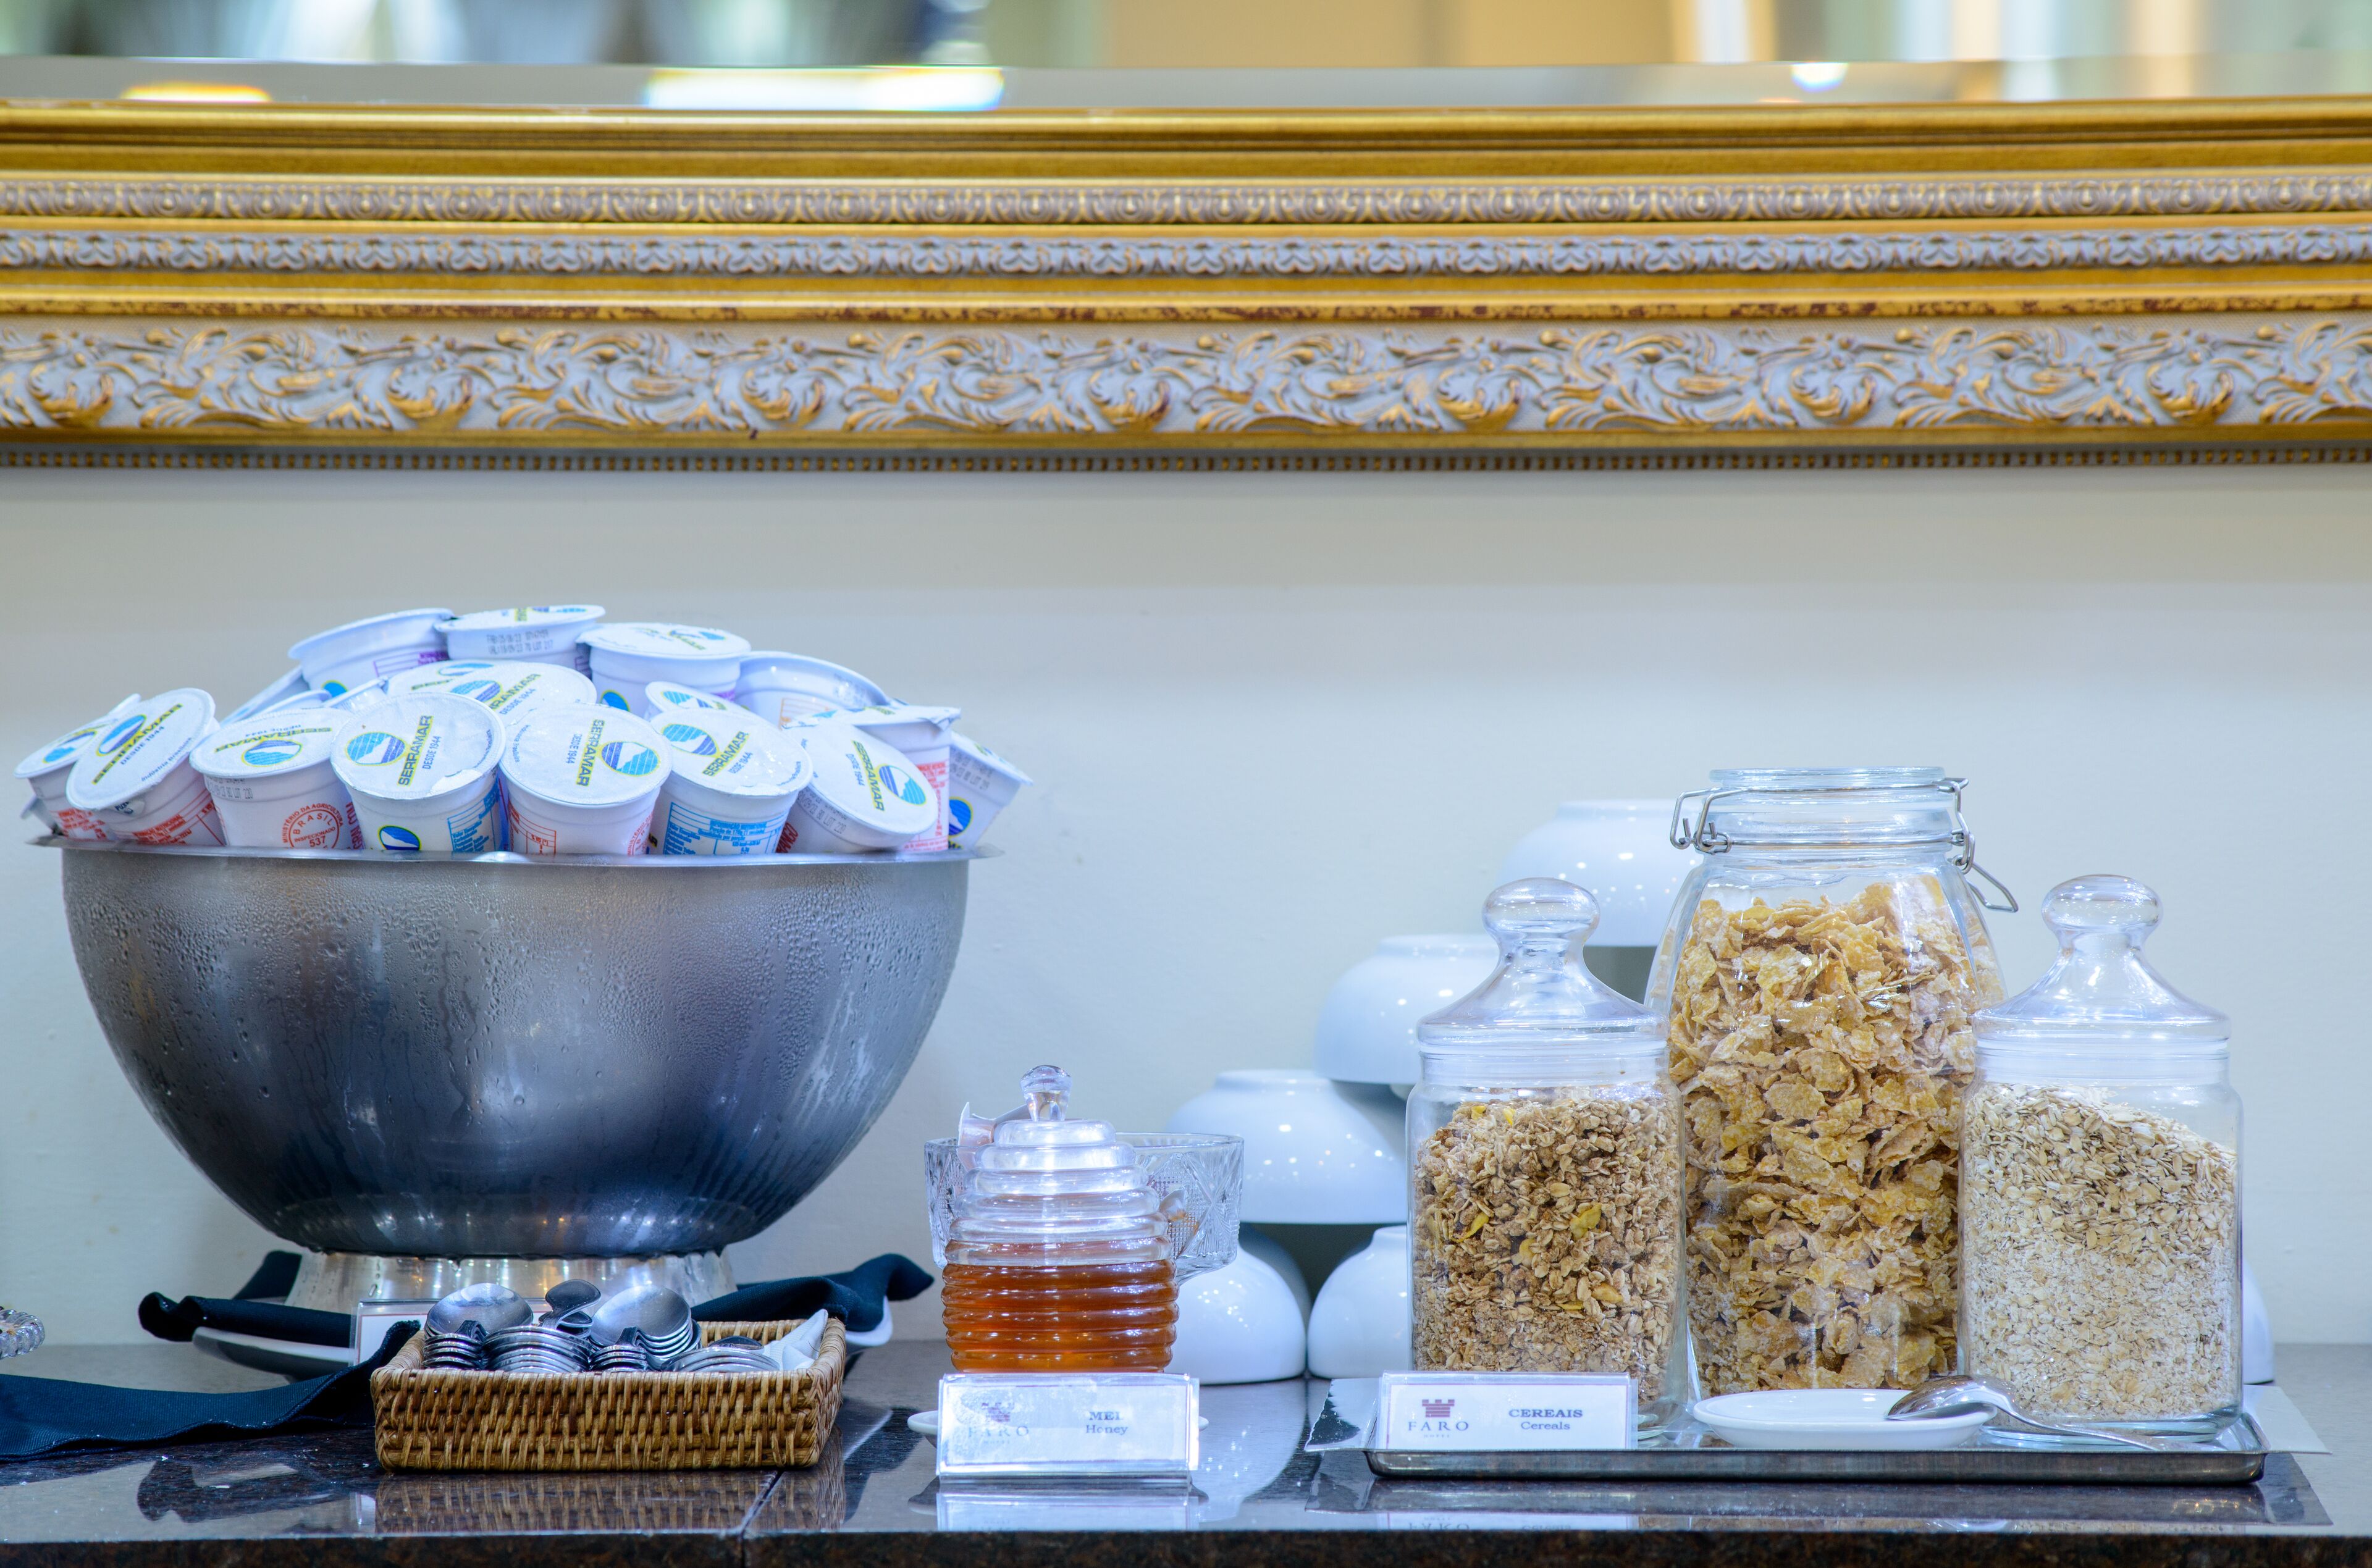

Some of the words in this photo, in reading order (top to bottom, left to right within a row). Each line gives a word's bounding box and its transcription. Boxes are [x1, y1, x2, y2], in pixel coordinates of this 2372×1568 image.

[500, 700, 520, 715] DESDE
[519, 688, 536, 702] 1944
[93, 703, 182, 784] SERRAMAR
[120, 742, 146, 765] DESDE
[146, 726, 165, 742] 1944
[215, 727, 332, 753] SERRAMAR
[398, 716, 433, 786] SERRAMAR
[423, 750, 435, 769] DESDE
[430, 736, 442, 750] 1944
[571, 733, 582, 749] DESDE
[578, 719, 604, 786] SERRAMAR
[566, 748, 577, 764] 1944
[703, 731, 749, 777] SERRAMAR
[728, 761, 742, 774] DESDE
[740, 752, 753, 766] 1944
[846, 753, 860, 773] DESDE
[854, 771, 865, 787] 1944
[852, 740, 885, 811] SERRAMAR
[282, 810, 300, 843] MINISTÉRIO
[300, 805, 310, 814] DA
[311, 803, 343, 827] AGRICULTURA
[293, 812, 333, 835] BRASIL
[294, 826, 335, 843] INSPECIONADO
[309, 835, 326, 848] 537
[1408, 1421, 1469, 1432] FARO
[1508, 1409, 1583, 1418] CEREAIS
[1520, 1421, 1570, 1430] Cereals
[1085, 1425, 1129, 1436] Honey
